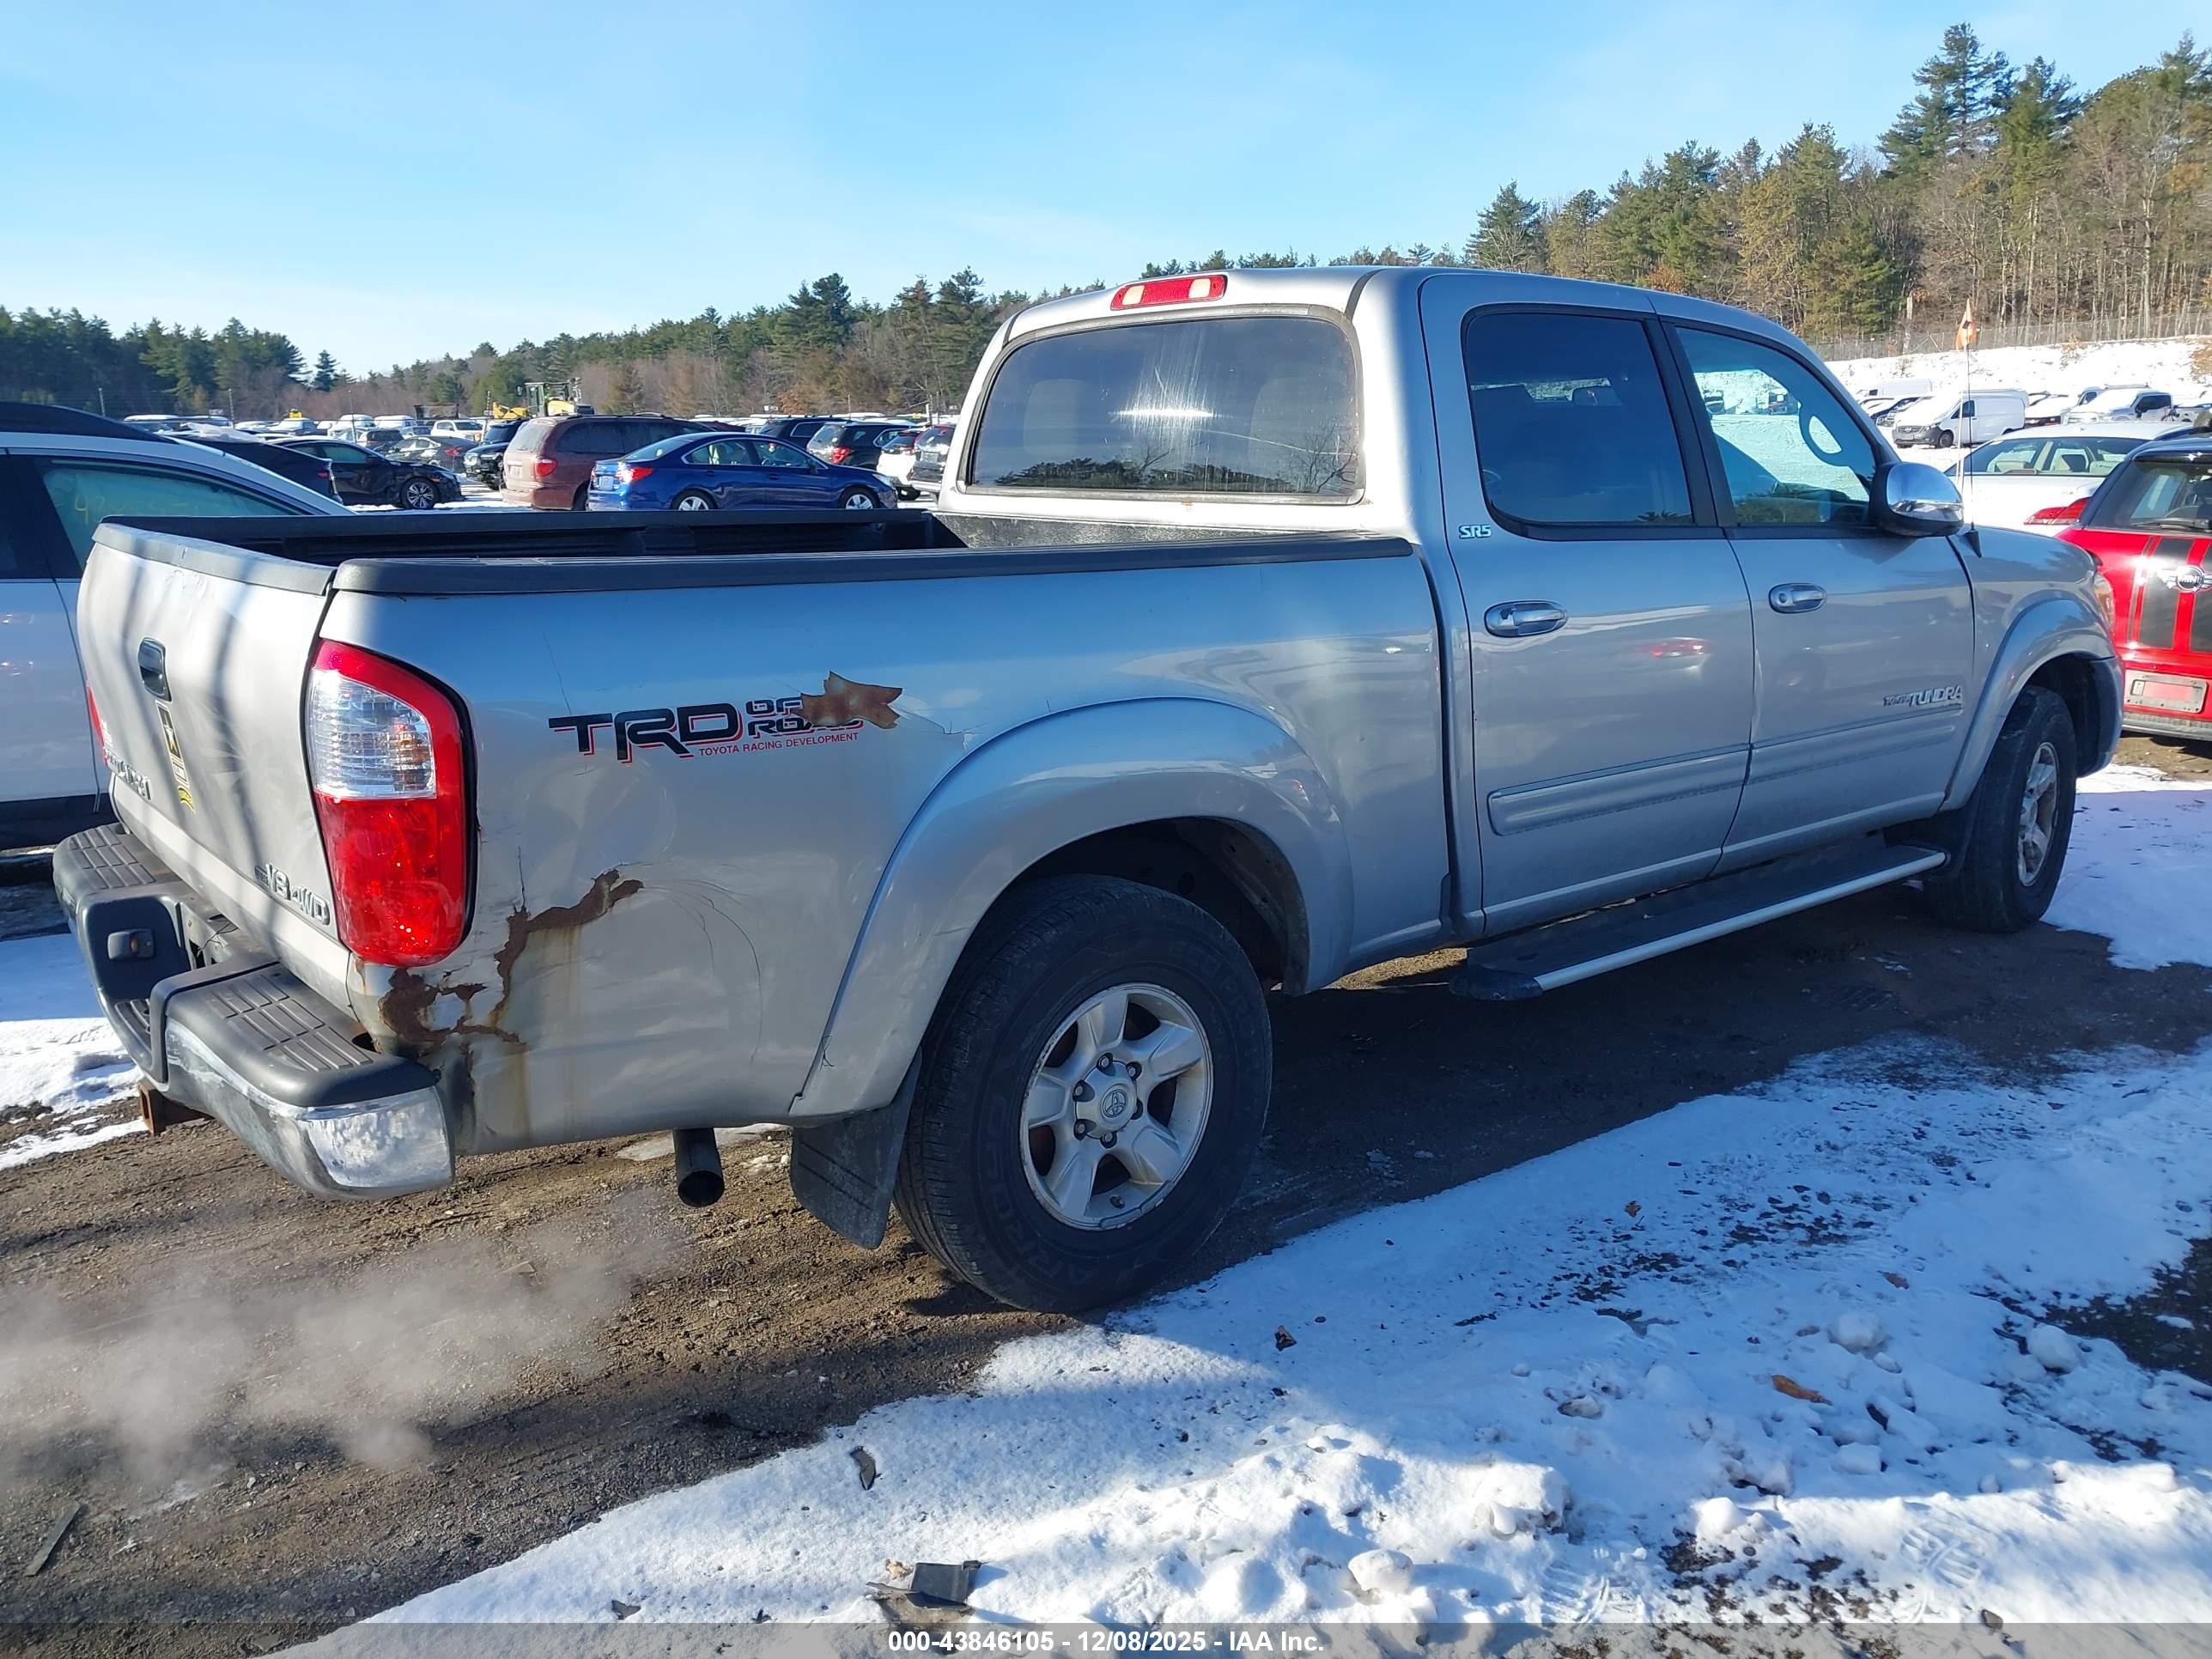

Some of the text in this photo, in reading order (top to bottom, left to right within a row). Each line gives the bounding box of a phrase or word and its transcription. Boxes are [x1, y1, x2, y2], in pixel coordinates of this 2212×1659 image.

[1459, 525, 1492, 538] SR5
[1909, 685, 1963, 707] TUNDRA
[549, 703, 744, 763] TRD
[699, 732, 859, 757] TOYOTA RACING DEVELOPMENT
[291, 886, 331, 926] 4WD
